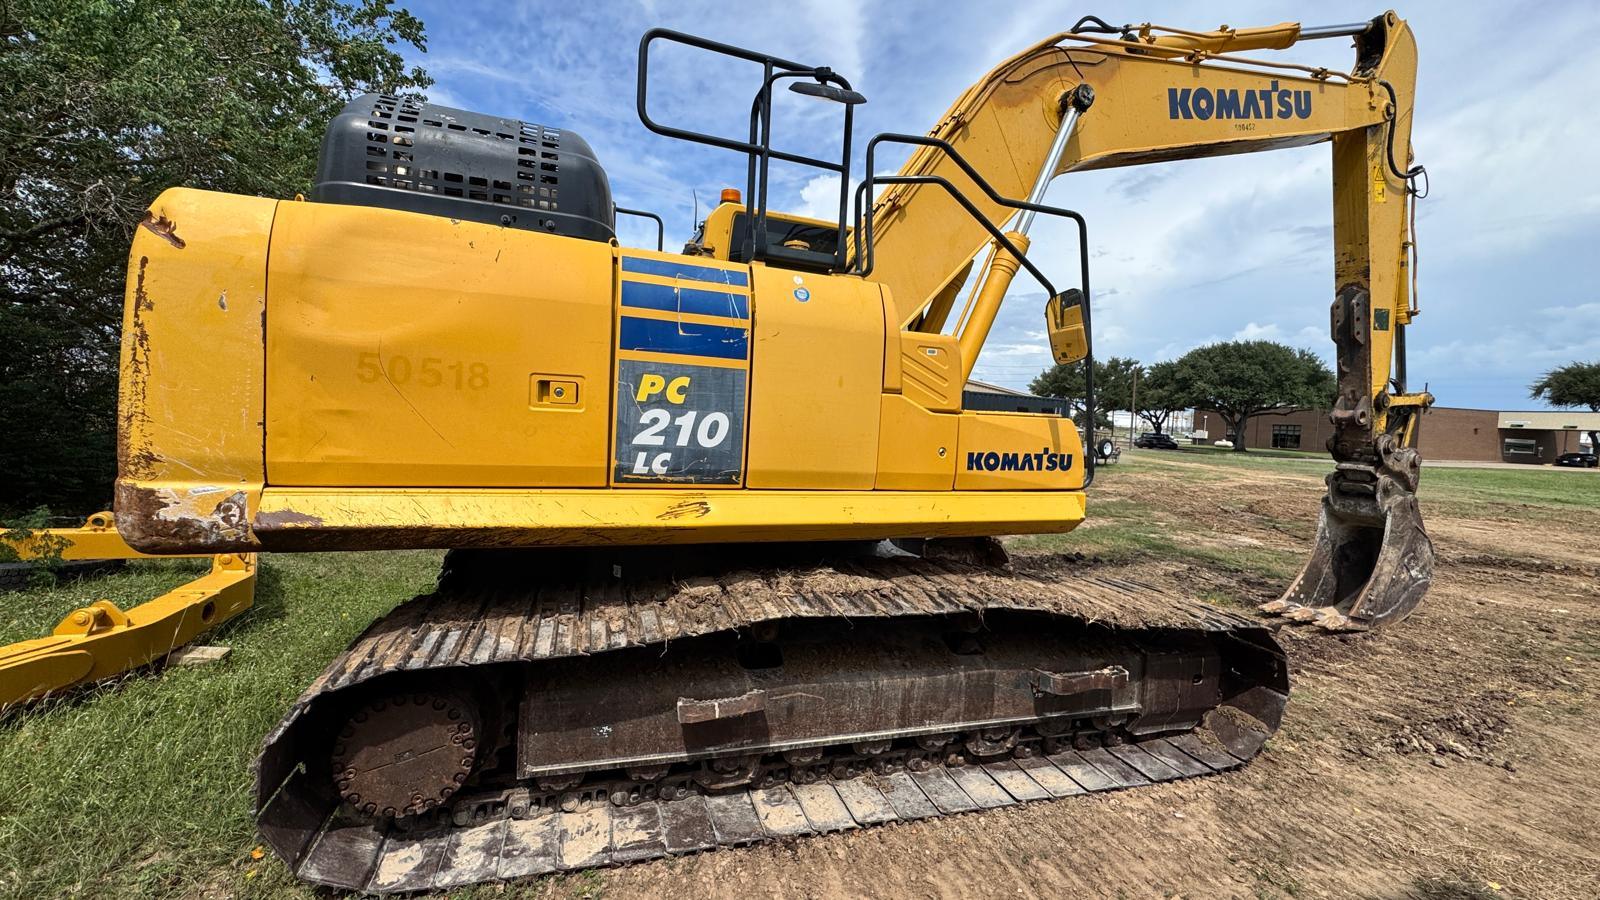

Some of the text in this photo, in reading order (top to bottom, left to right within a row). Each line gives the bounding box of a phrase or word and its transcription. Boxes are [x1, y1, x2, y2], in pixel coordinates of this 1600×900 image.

[1168, 80, 1312, 121] KOMATSU
[356, 351, 490, 391] 50518
[636, 373, 691, 405] PC
[631, 408, 730, 448] 210
[632, 451, 673, 474] LC
[966, 447, 1073, 471] KOMATSU
